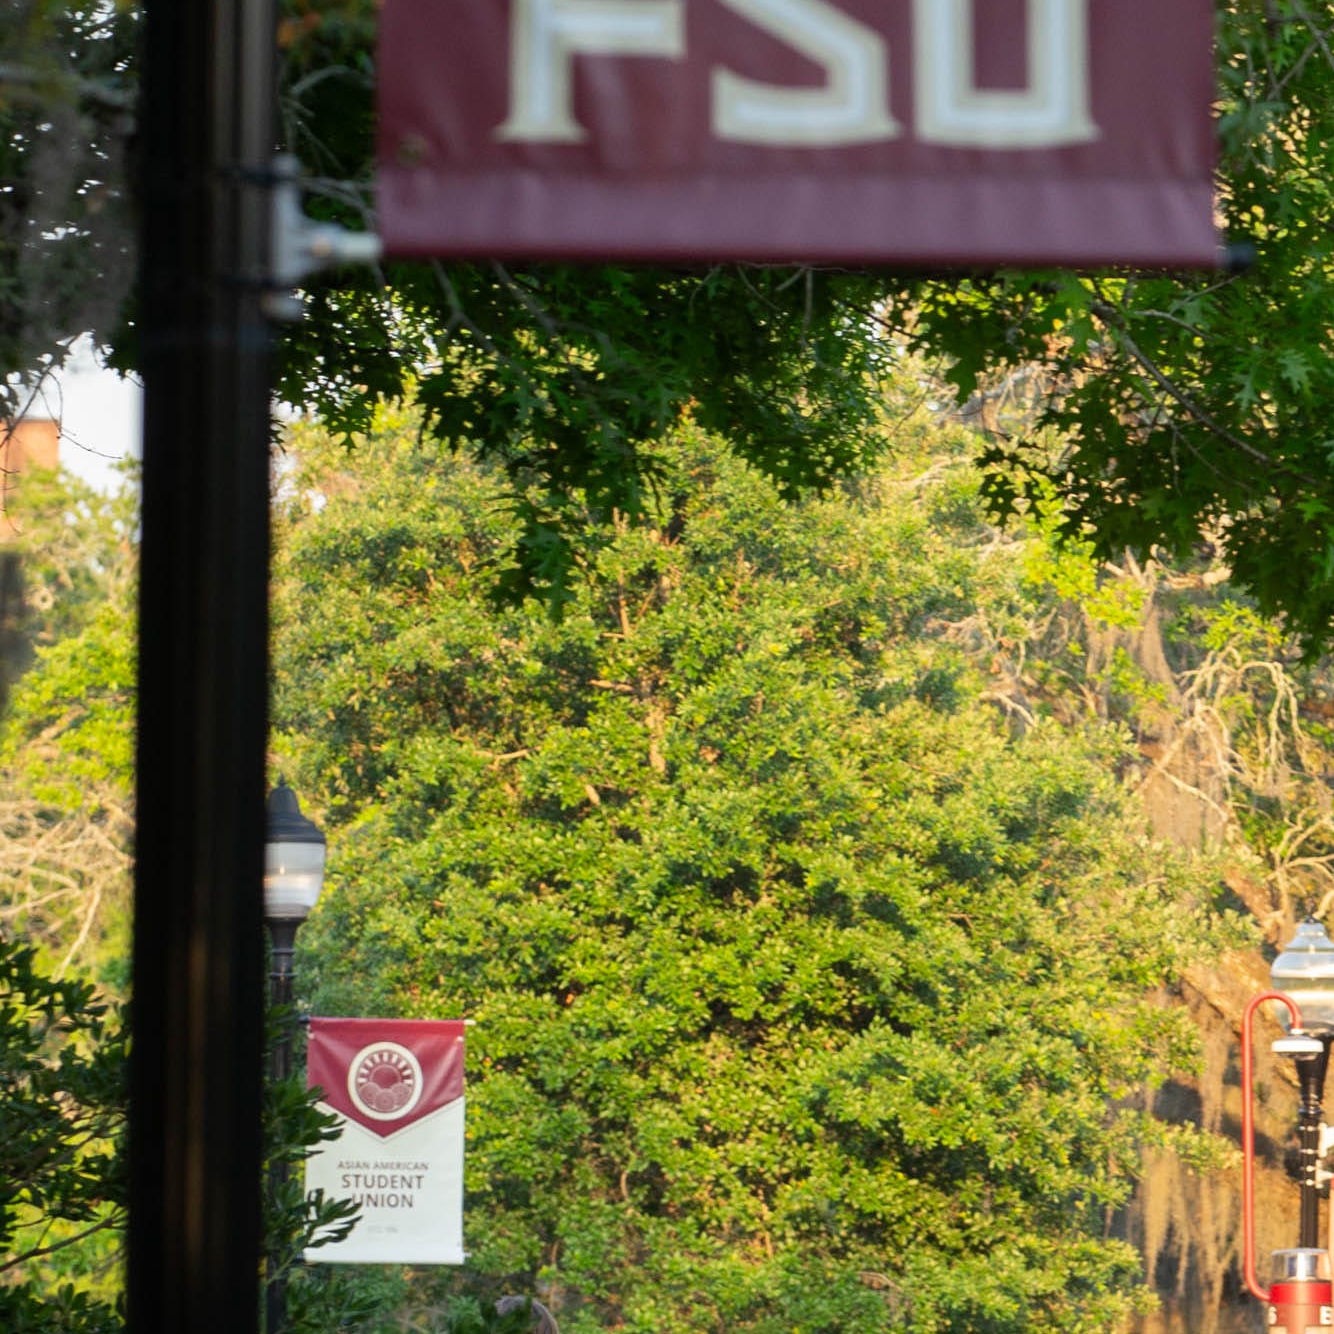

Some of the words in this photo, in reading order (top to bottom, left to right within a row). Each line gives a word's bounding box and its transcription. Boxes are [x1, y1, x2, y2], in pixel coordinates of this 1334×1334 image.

[338, 1161, 370, 1169] ASIAN
[373, 1162, 430, 1171] AMERICAN
[341, 1174, 425, 1189] STUDENT
[352, 1193, 414, 1208] UNION
